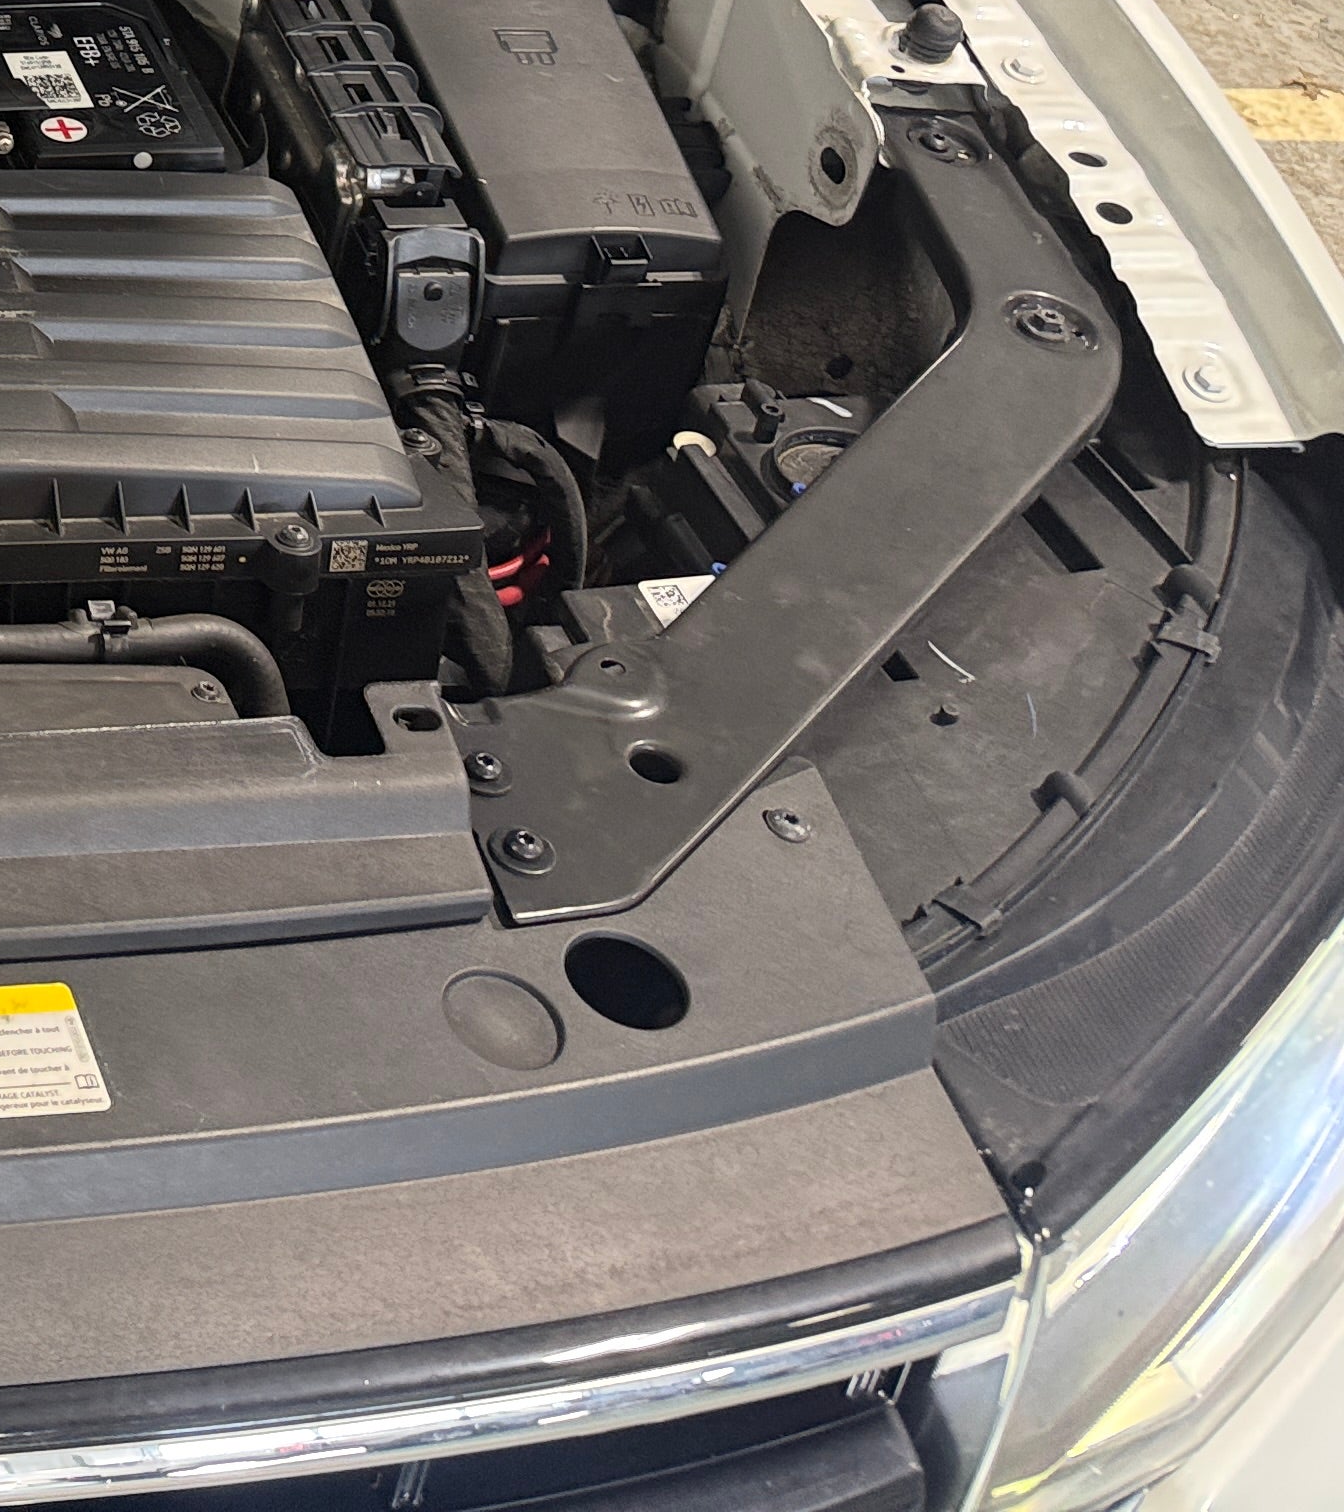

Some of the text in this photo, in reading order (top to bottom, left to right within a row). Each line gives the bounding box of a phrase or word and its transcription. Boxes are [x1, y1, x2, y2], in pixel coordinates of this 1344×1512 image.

[28, 16, 50, 46] CLARIOS
[73, 36, 102, 67] EFB+
[30, 1046, 73, 1056] TOUCHING
[31, 1064, 62, 1073] toucher
[30, 1101, 49, 1109] pour
